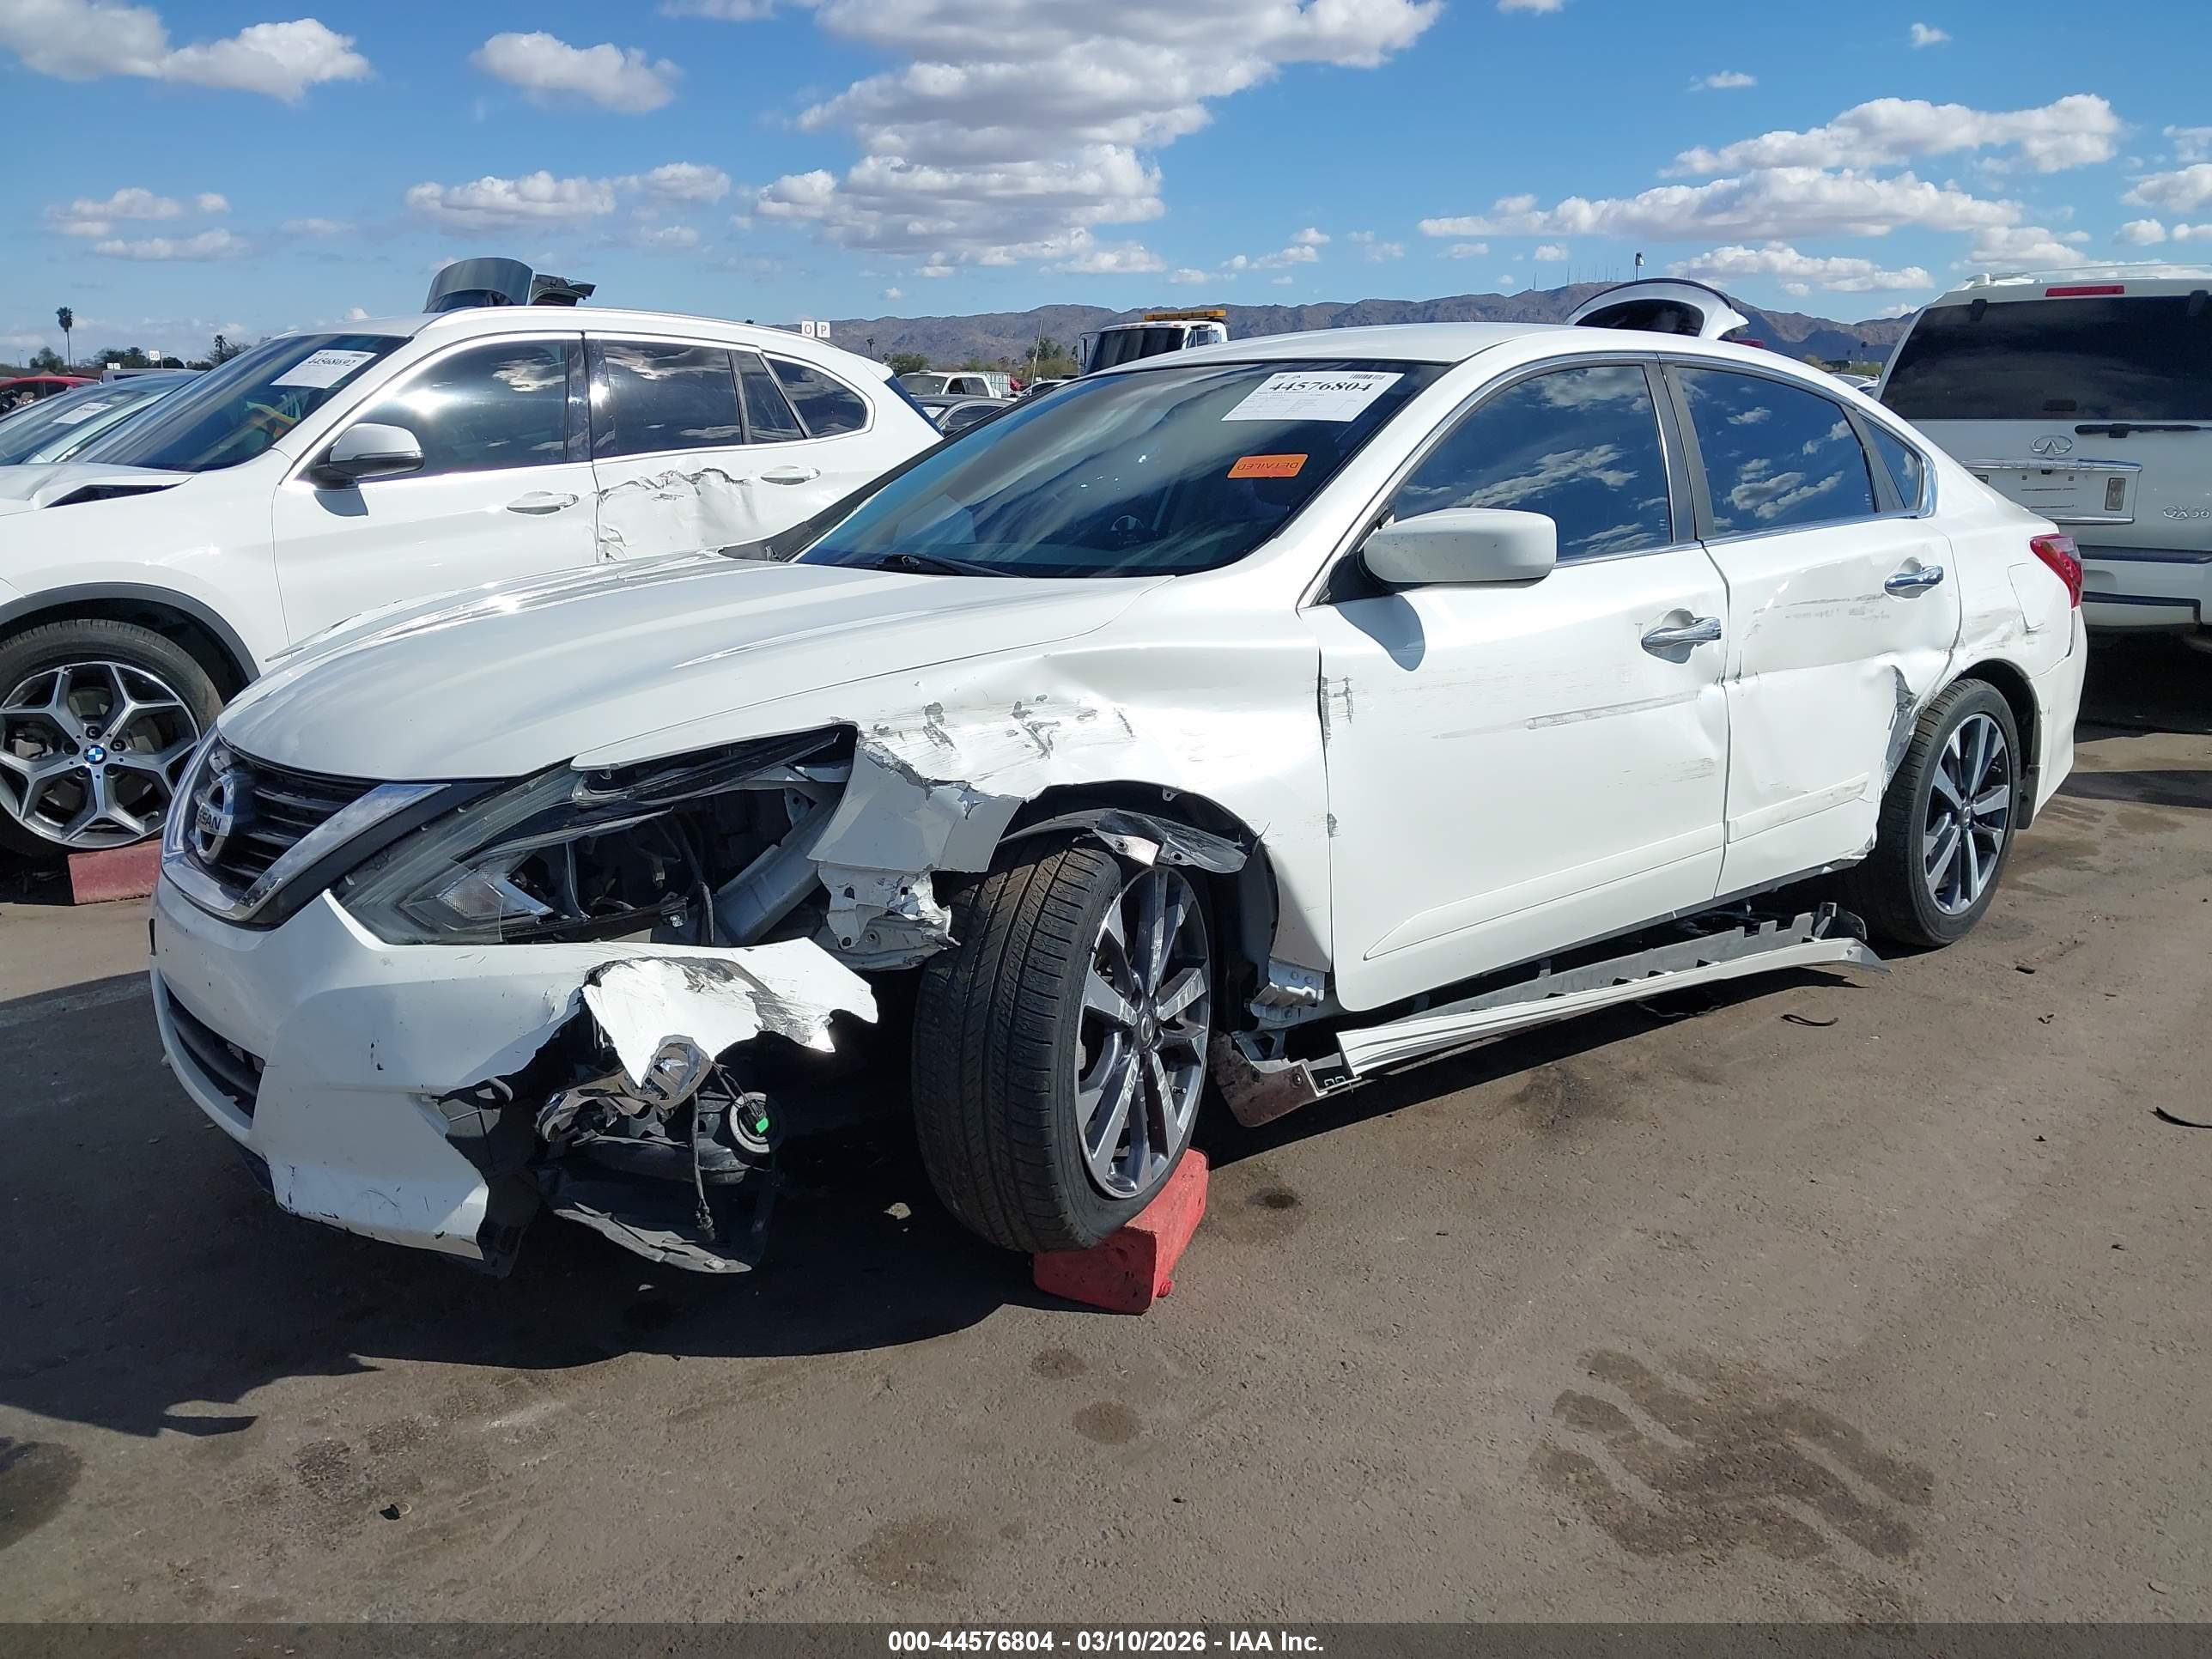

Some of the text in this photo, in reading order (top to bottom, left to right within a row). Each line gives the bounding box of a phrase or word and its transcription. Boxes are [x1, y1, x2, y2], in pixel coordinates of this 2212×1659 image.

[805, 325, 811, 334] O
[821, 325, 826, 335] P
[1269, 381, 1375, 392] 44576804
[1237, 461, 1299, 471] DETAILED
